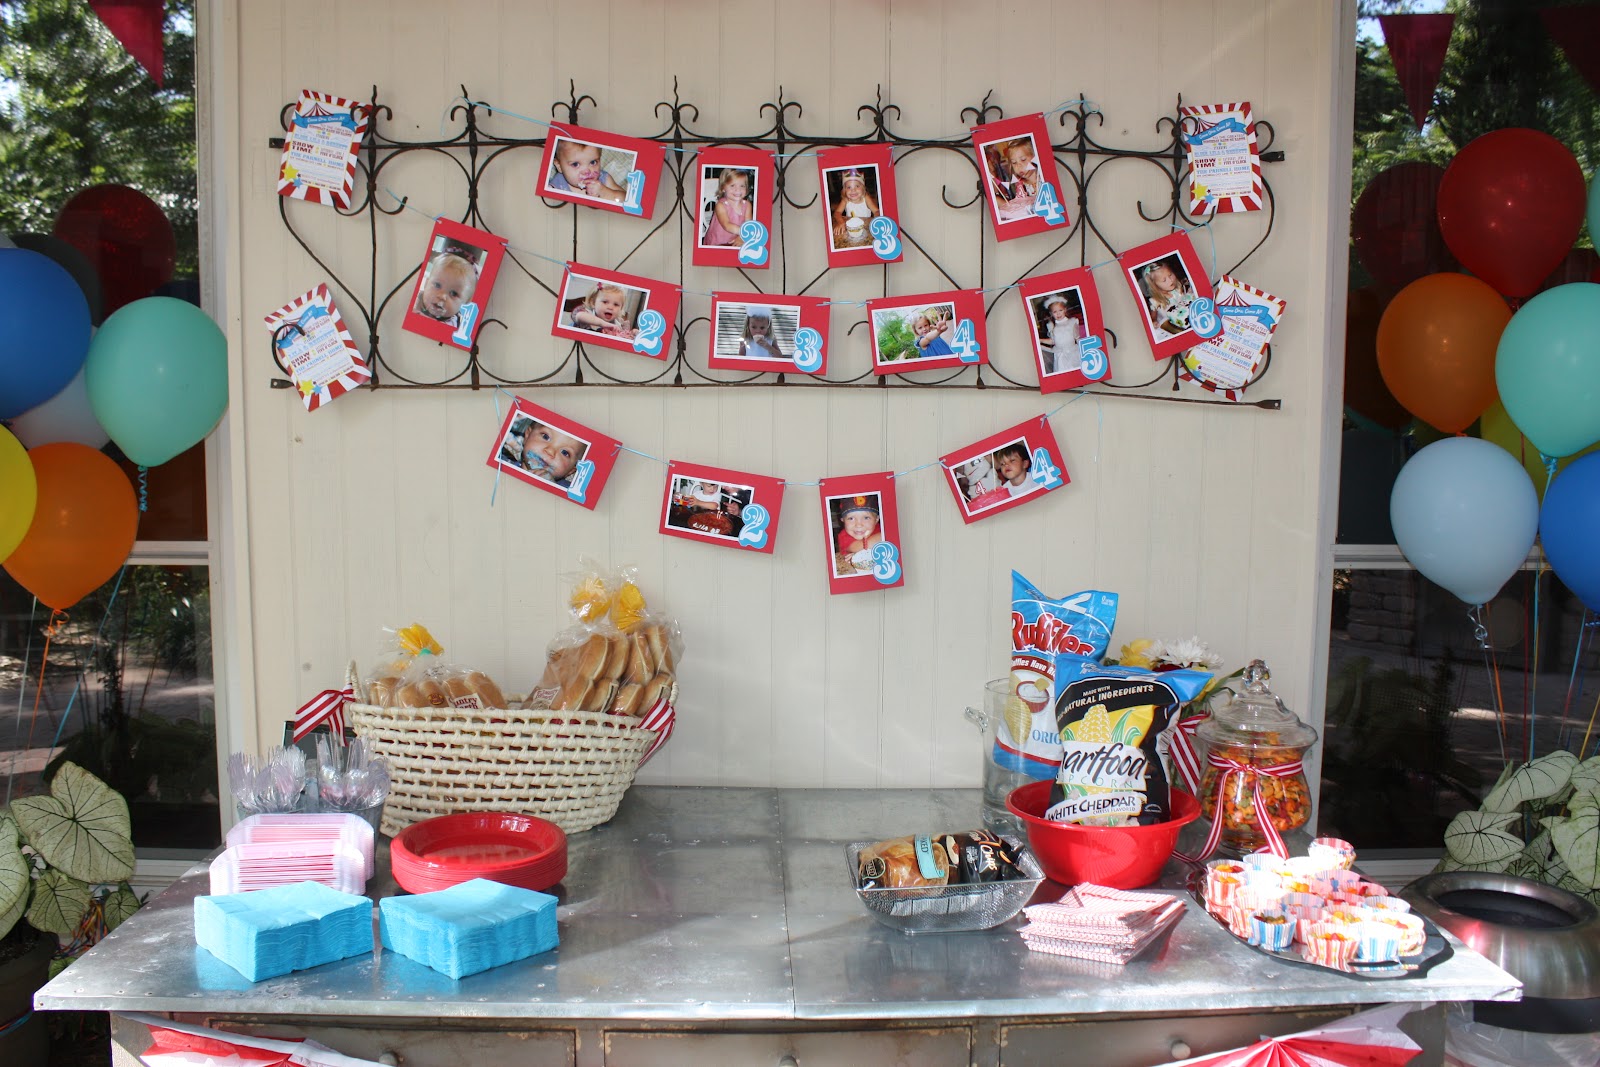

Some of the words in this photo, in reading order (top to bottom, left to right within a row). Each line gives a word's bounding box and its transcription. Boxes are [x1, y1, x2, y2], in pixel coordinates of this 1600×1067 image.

[292, 141, 314, 149] SHOW
[292, 145, 312, 154] TIME
[624, 170, 643, 213] 1
[1034, 182, 1064, 223] 4
[738, 221, 766, 262] 2
[870, 216, 900, 258] 3
[452, 303, 477, 346] 1
[633, 310, 664, 354] 2
[1190, 297, 1220, 336] 6
[291, 352, 311, 364] SHOW
[794, 328, 821, 370] 3
[950, 319, 978, 360] 4
[1079, 336, 1106, 378] 5
[293, 356, 311, 368] TIME
[567, 460, 594, 502] 1
[1031, 447, 1061, 488] 4
[739, 504, 768, 547] 2
[872, 541, 900, 582] 3
[1030, 659, 1047, 672] Have
[1082, 688, 1097, 697] MADE
[1097, 685, 1111, 693] WITH
[1098, 684, 1154, 701] INGREDIENTS
[1032, 729, 1063, 746] ORIG
[1060, 774, 1133, 789] PCORN
[1047, 803, 1078, 821] WHITE
[1079, 796, 1136, 812] CHEDDAR
[980, 844, 997, 871] Chips
